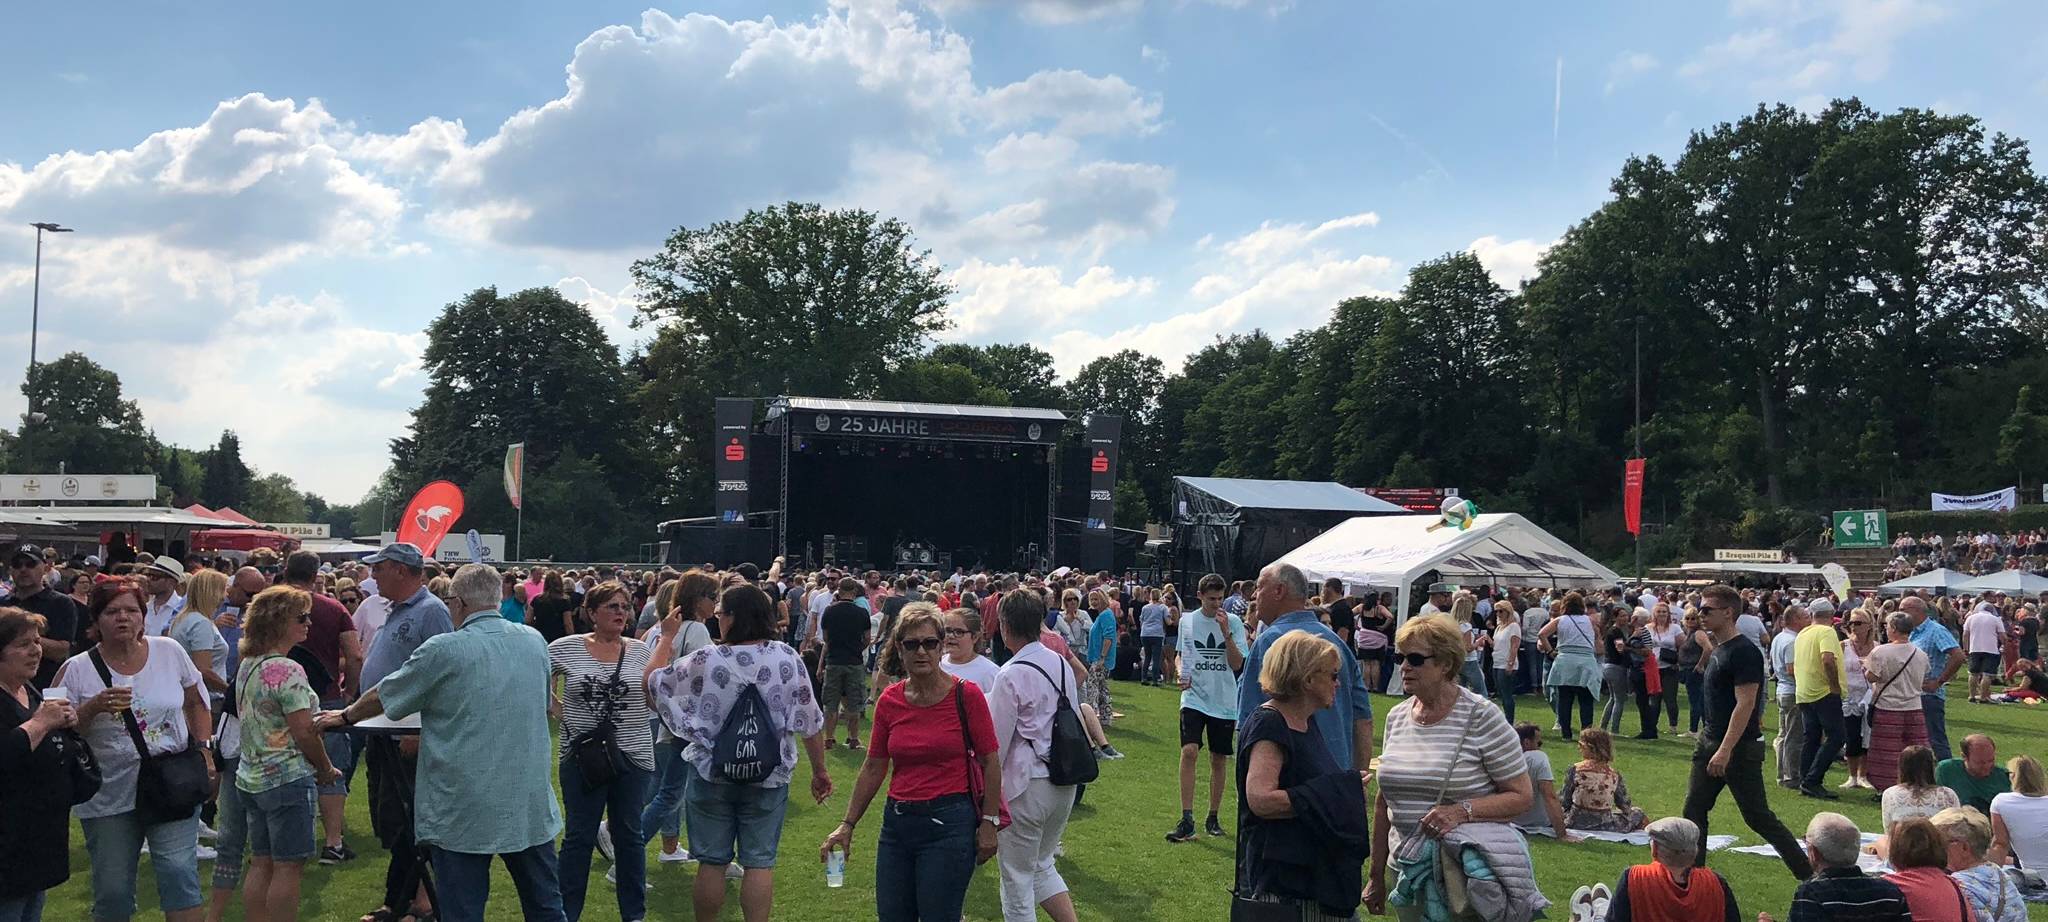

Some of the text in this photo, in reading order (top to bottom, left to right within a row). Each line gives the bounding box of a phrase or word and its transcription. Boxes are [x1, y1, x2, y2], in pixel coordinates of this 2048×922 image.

[841, 416, 864, 432] 25
[868, 417, 929, 435] JAHRE
[1195, 661, 1227, 671] adidas
[736, 740, 757, 759] GAR
[724, 761, 762, 779] NICHTS
